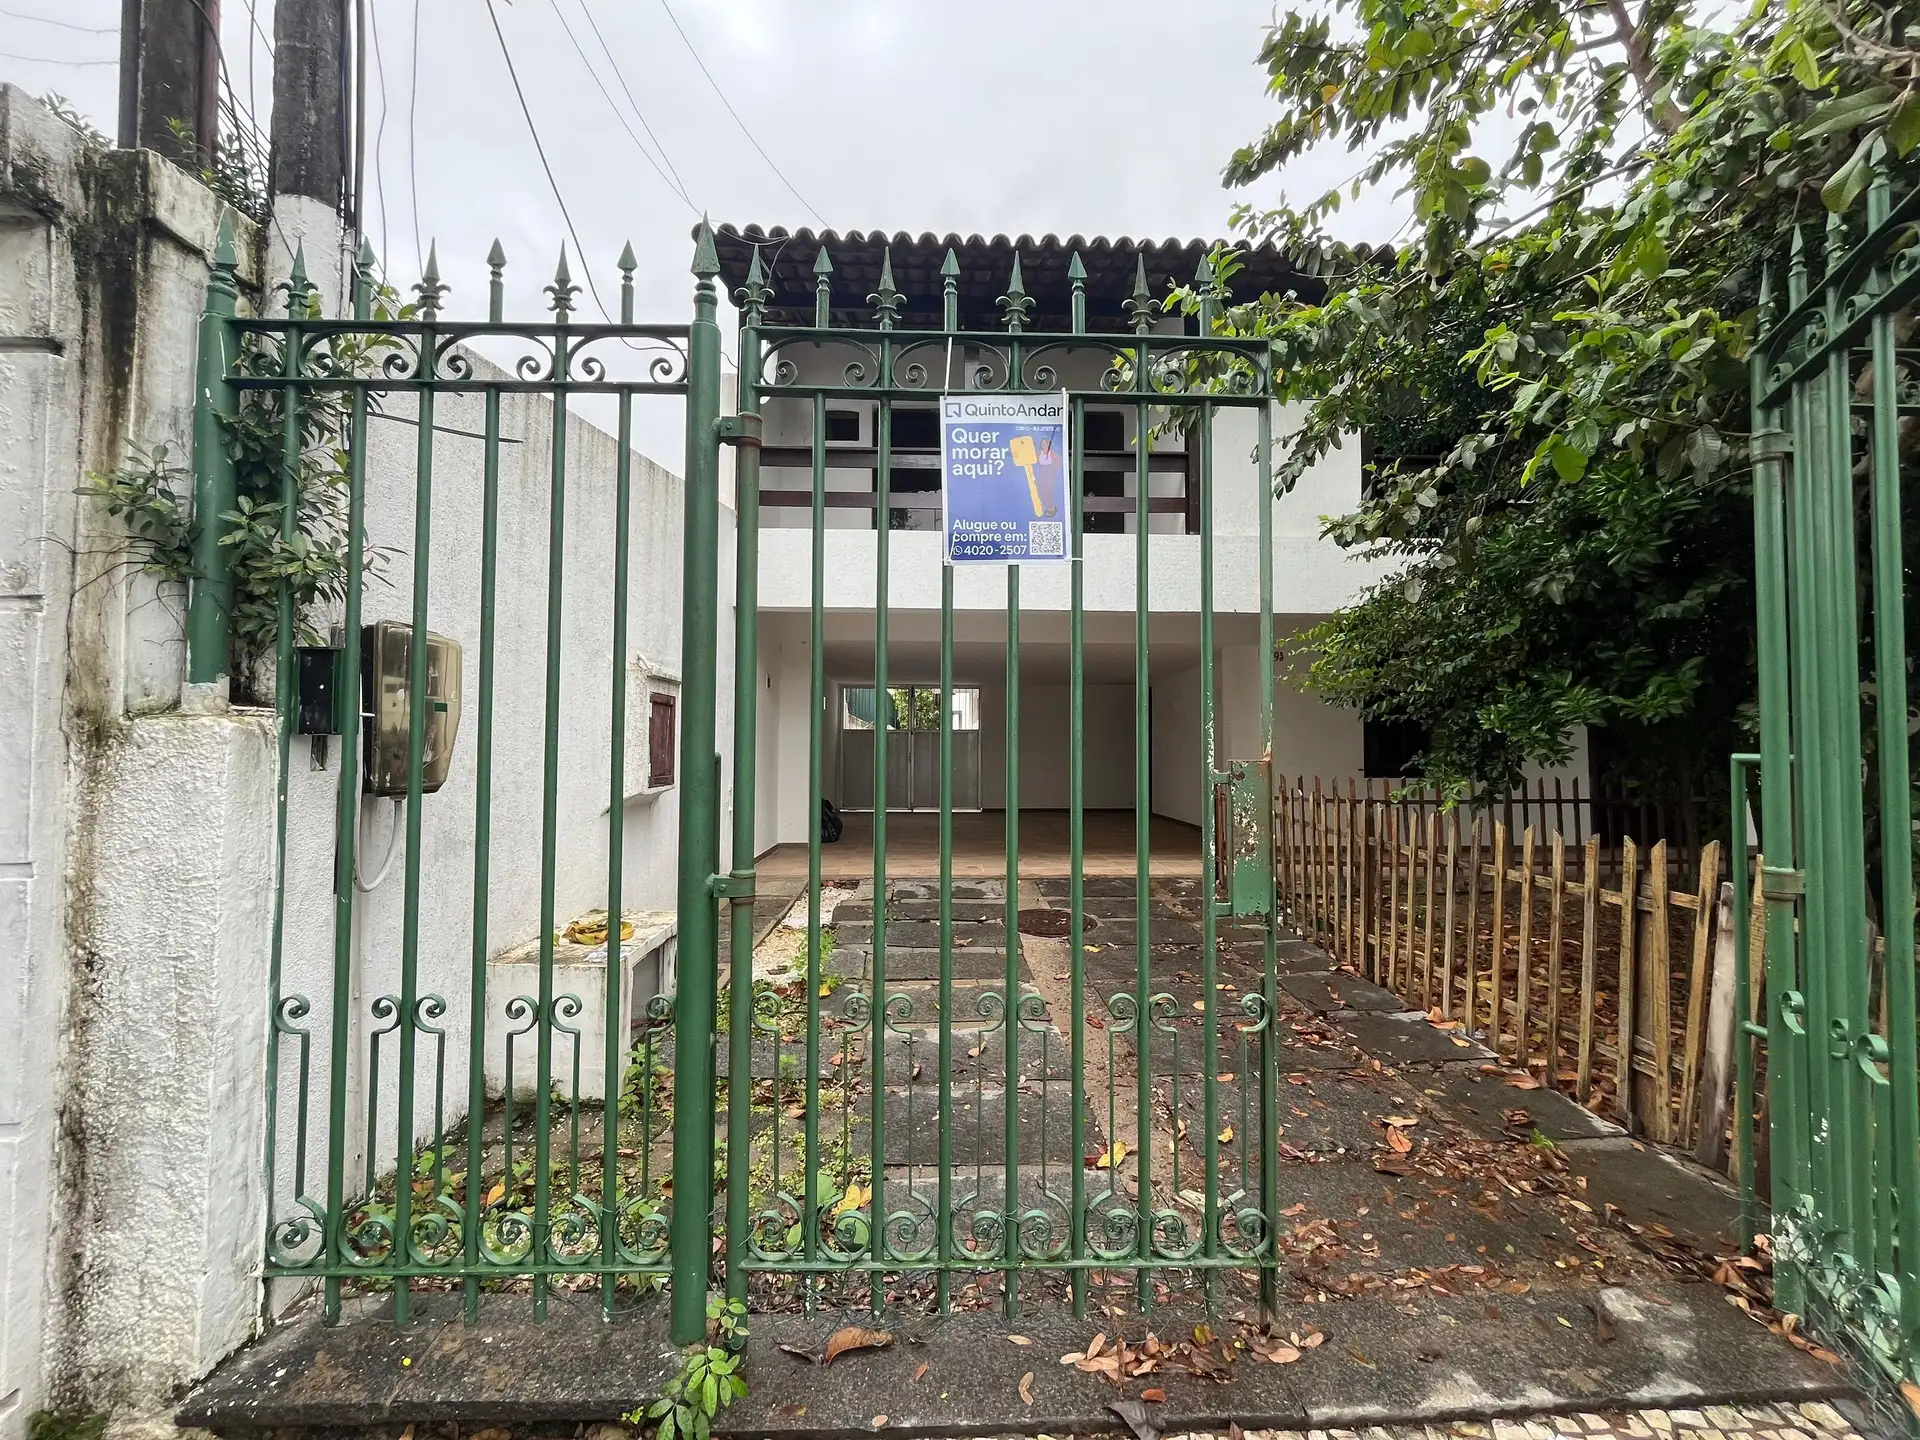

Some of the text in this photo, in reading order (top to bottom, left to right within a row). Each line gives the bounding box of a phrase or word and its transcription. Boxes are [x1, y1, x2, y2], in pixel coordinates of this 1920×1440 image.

[965, 403, 1063, 417] QuintoAndar
[951, 428, 1000, 444] Quer
[952, 446, 1009, 460] morar
[952, 460, 1005, 479] aqui?
[952, 519, 1017, 533] Alugue ou
[952, 532, 1028, 544] compre em:
